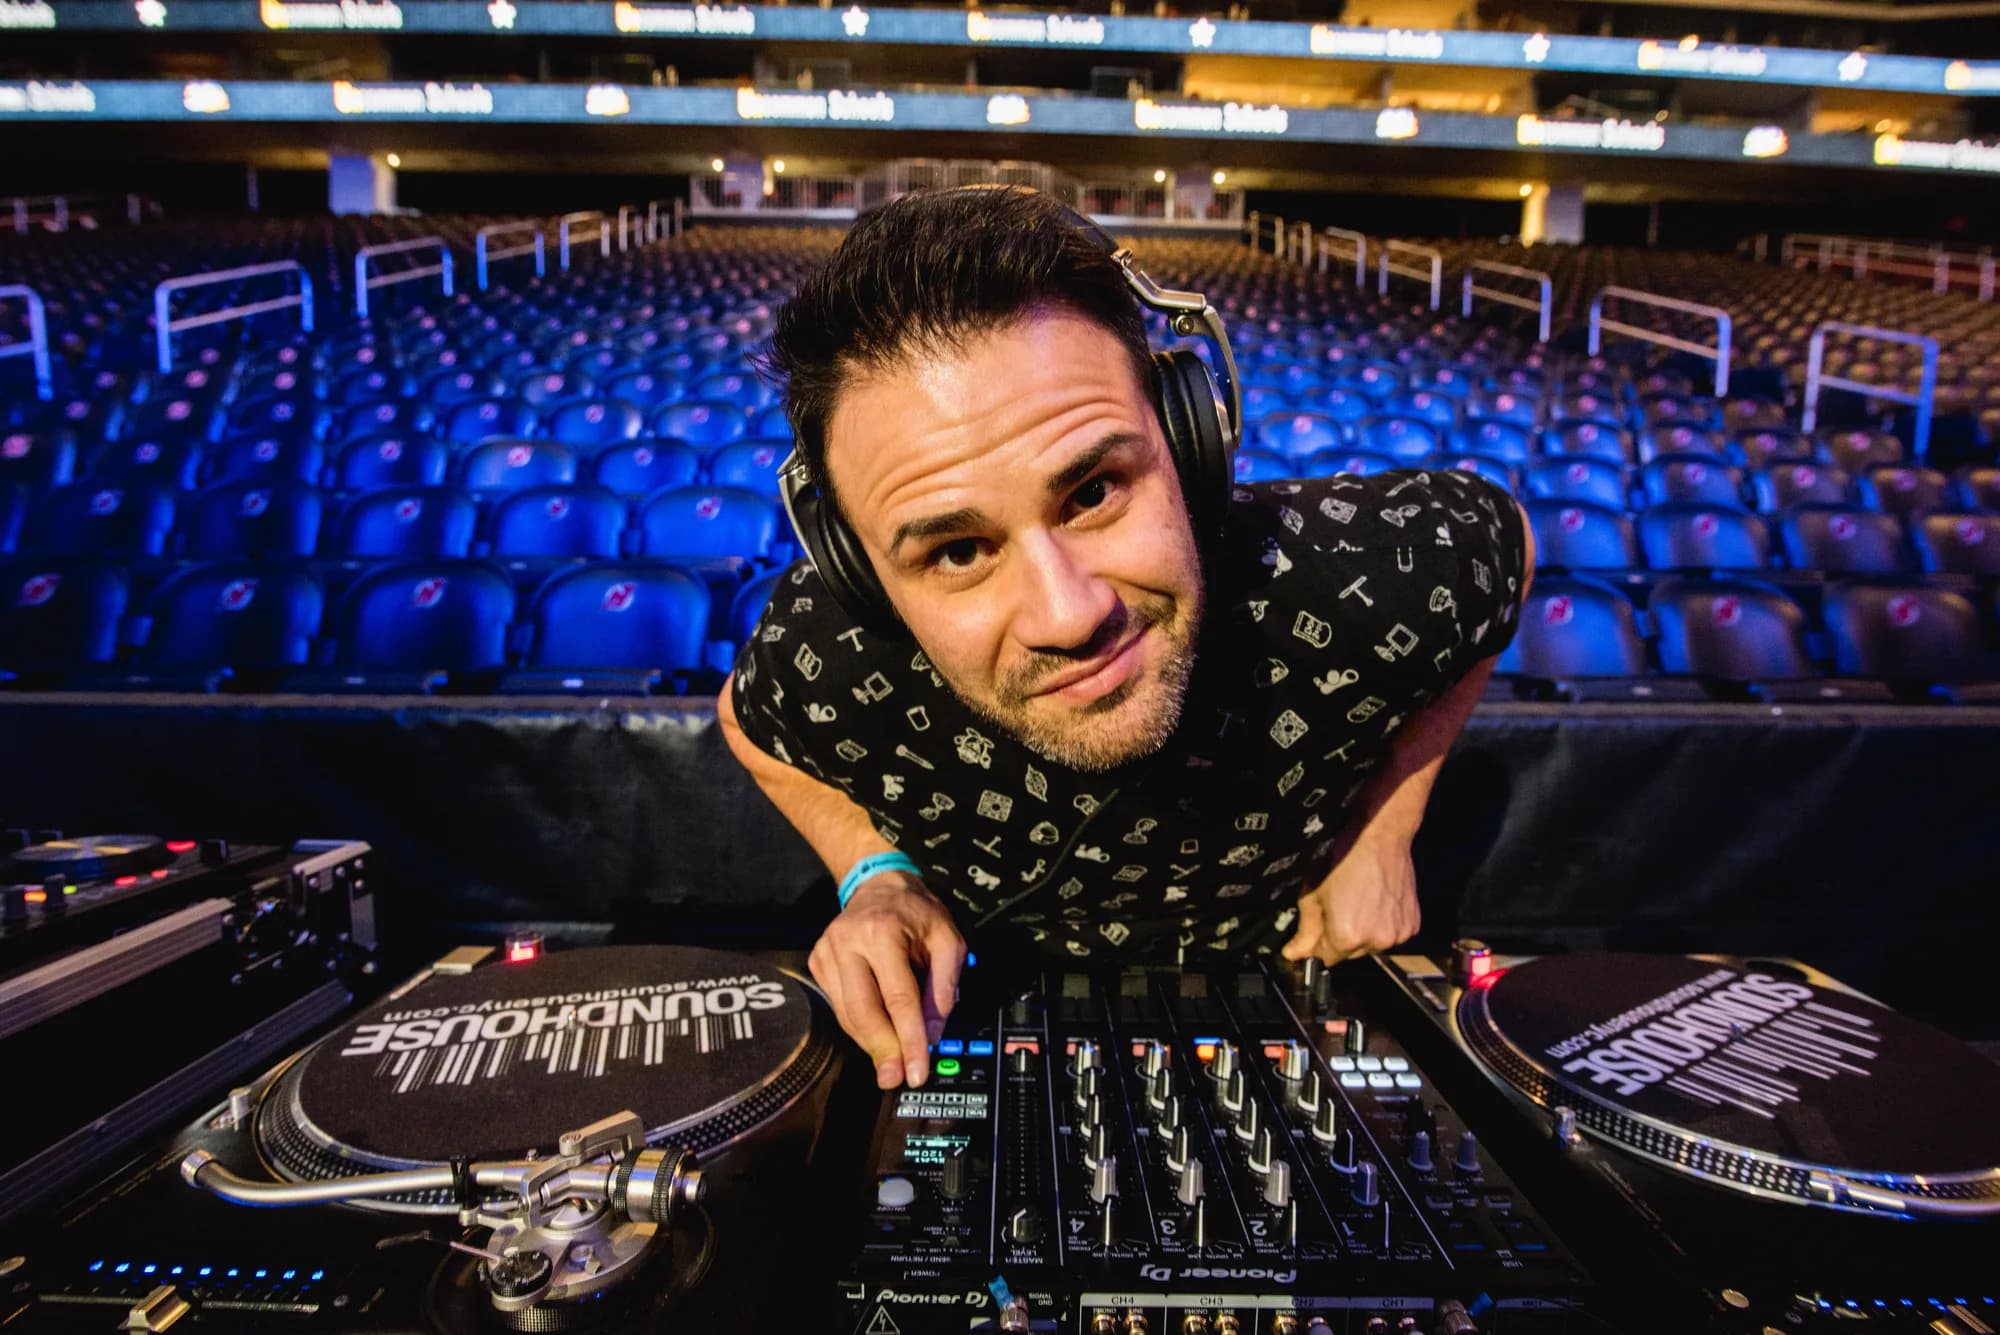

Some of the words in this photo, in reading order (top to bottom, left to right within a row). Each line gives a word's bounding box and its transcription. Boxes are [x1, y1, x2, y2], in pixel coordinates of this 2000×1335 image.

[341, 982, 786, 1057] SOUNDHOUSE
[1562, 973, 1815, 1097] SOUNDHOUSE
[1069, 1217, 1086, 1233] 4
[1160, 1218, 1177, 1235] 3
[1249, 1220, 1268, 1236] 2
[1341, 1221, 1355, 1236] 1
[1179, 1268, 1297, 1284] Pioneer
[877, 1289, 961, 1305] Pioneer
[1111, 1296, 1134, 1305] CH4
[1200, 1297, 1223, 1306] CH3
[1382, 1298, 1405, 1307] CH1
